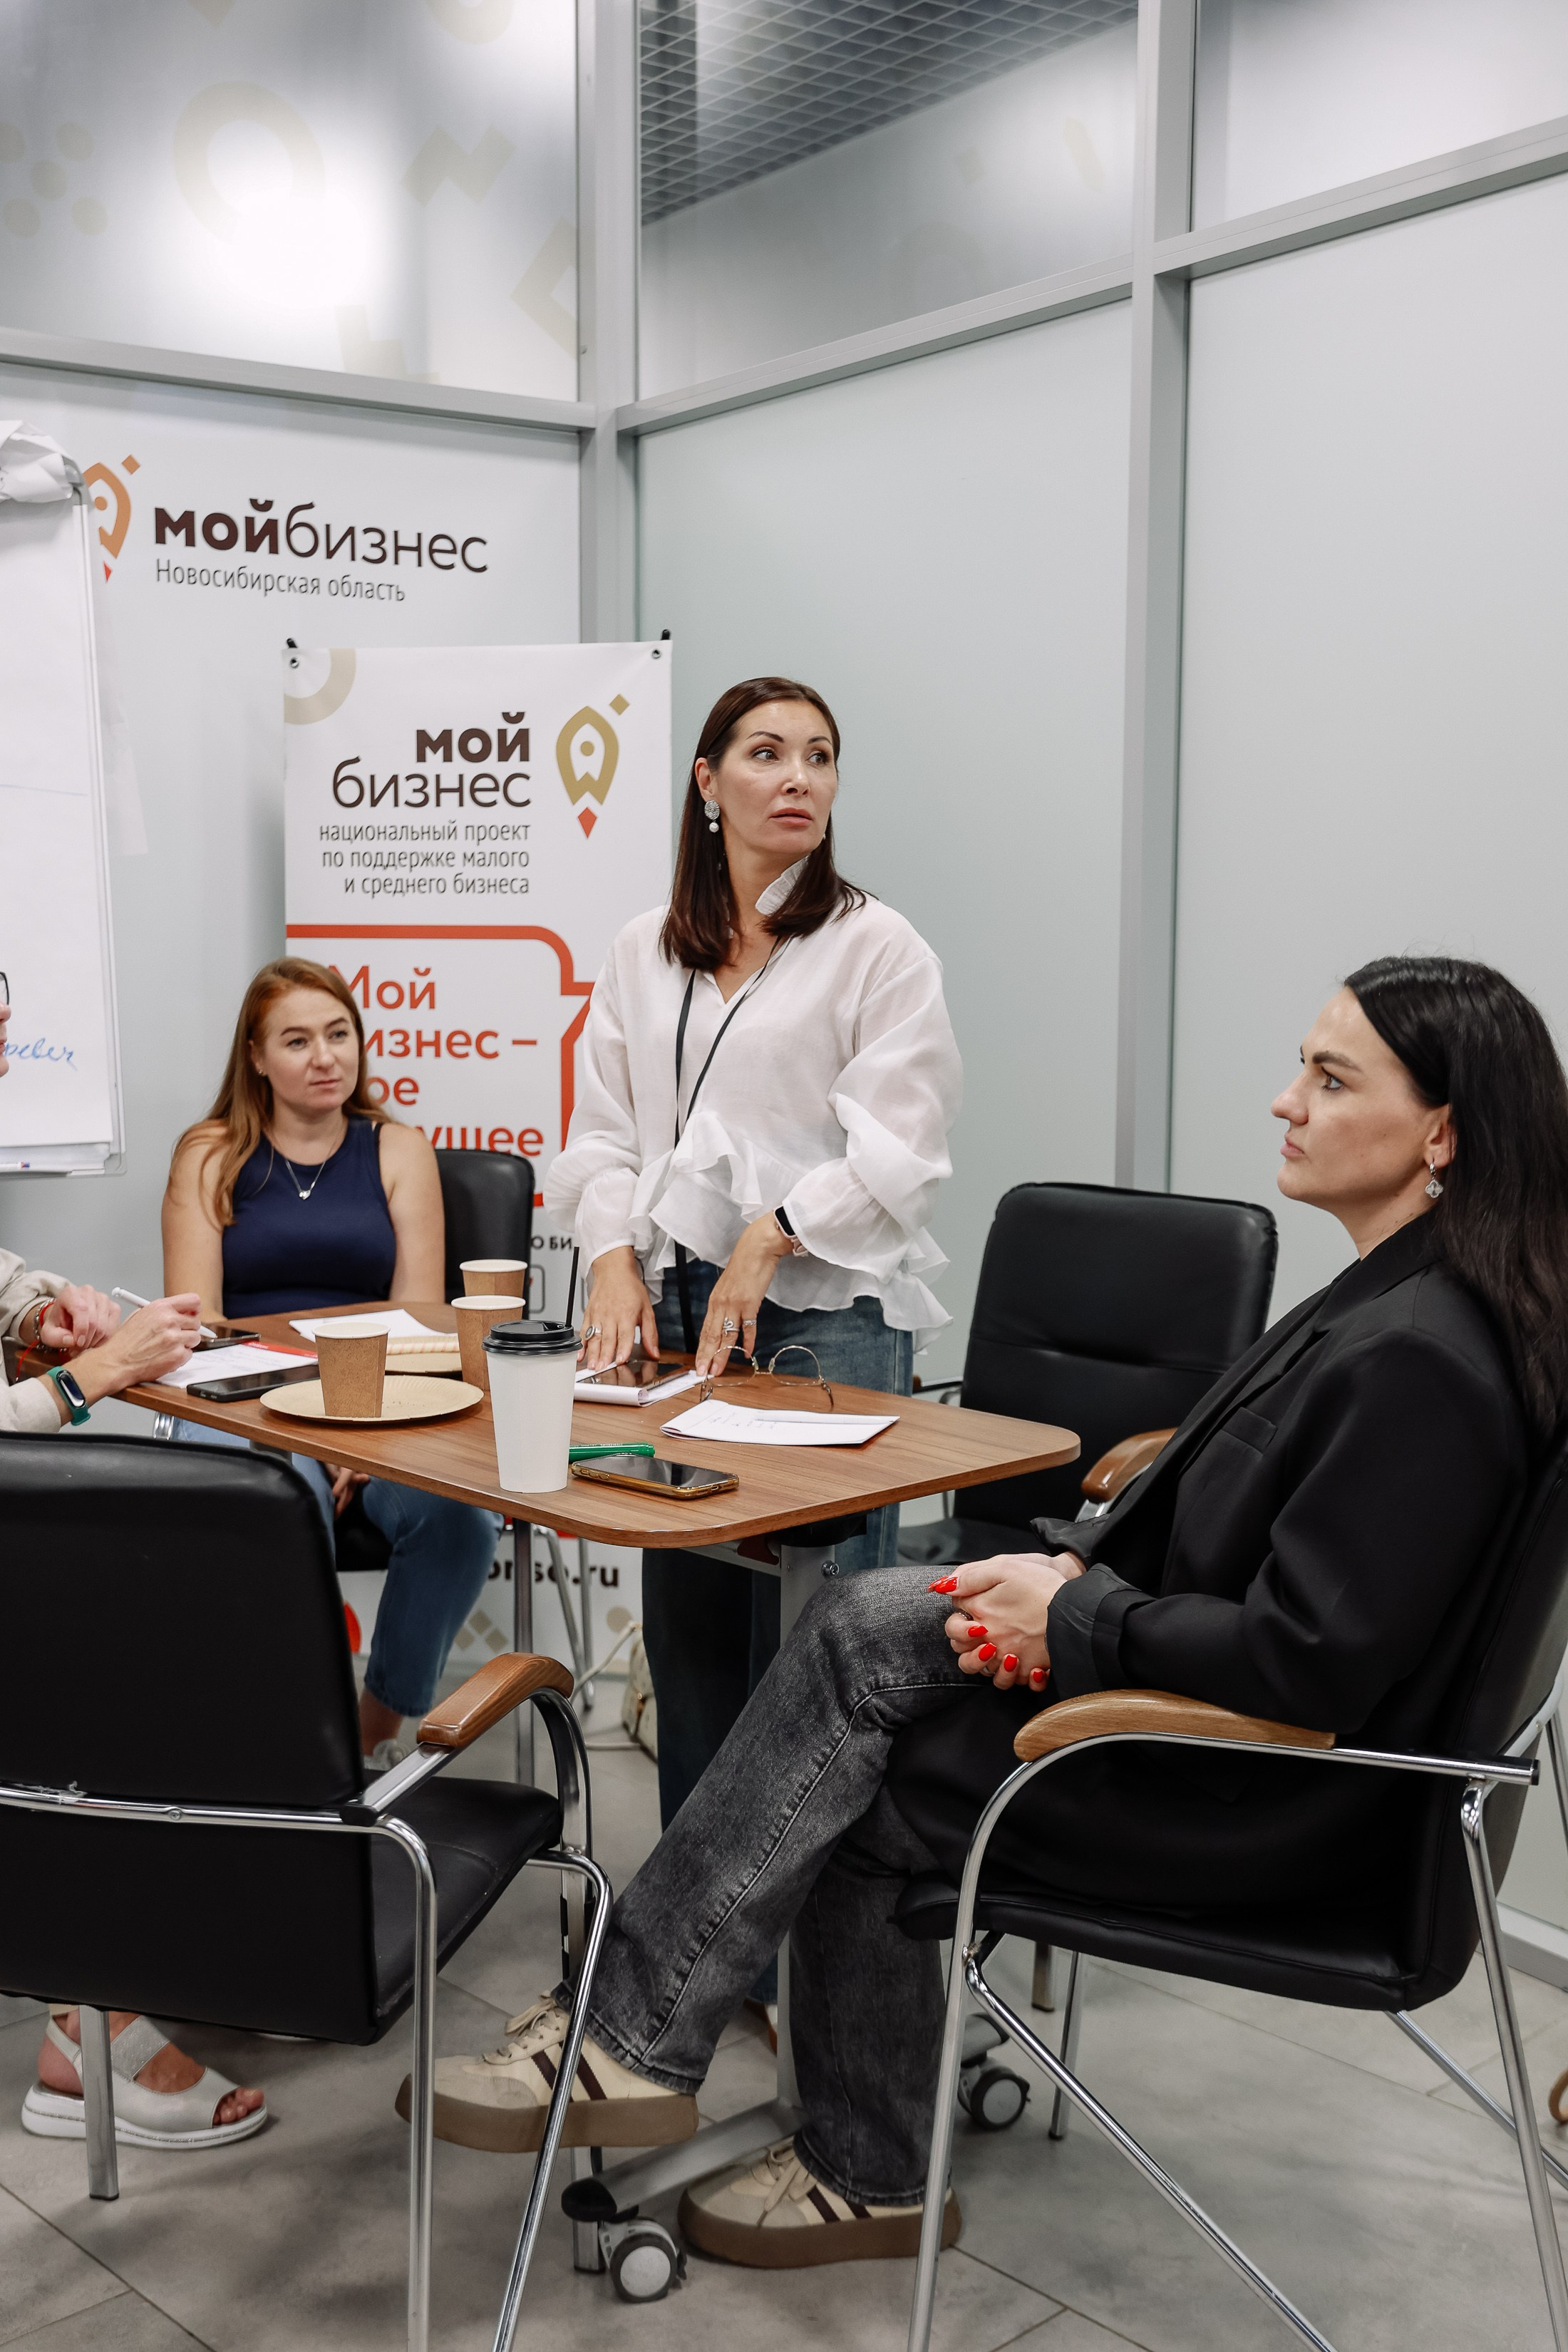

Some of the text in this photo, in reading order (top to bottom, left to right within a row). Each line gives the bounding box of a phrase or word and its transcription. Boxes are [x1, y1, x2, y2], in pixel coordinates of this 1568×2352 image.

[155, 497, 488, 573] мойбизнес
[156, 559, 406, 602] Новосибирская область
[416, 711, 530, 763] мой
[333, 755, 531, 808] бизнес
[320, 820, 530, 845] национальный проект
[322, 851, 530, 872] по поддержке малого
[344, 872, 530, 899] и среднего бизнеса
[329, 965, 436, 1009] Мой
[365, 1029, 500, 1059] изнес
[366, 1076, 419, 1105] ое
[549, 1236, 572, 1250] БИ
